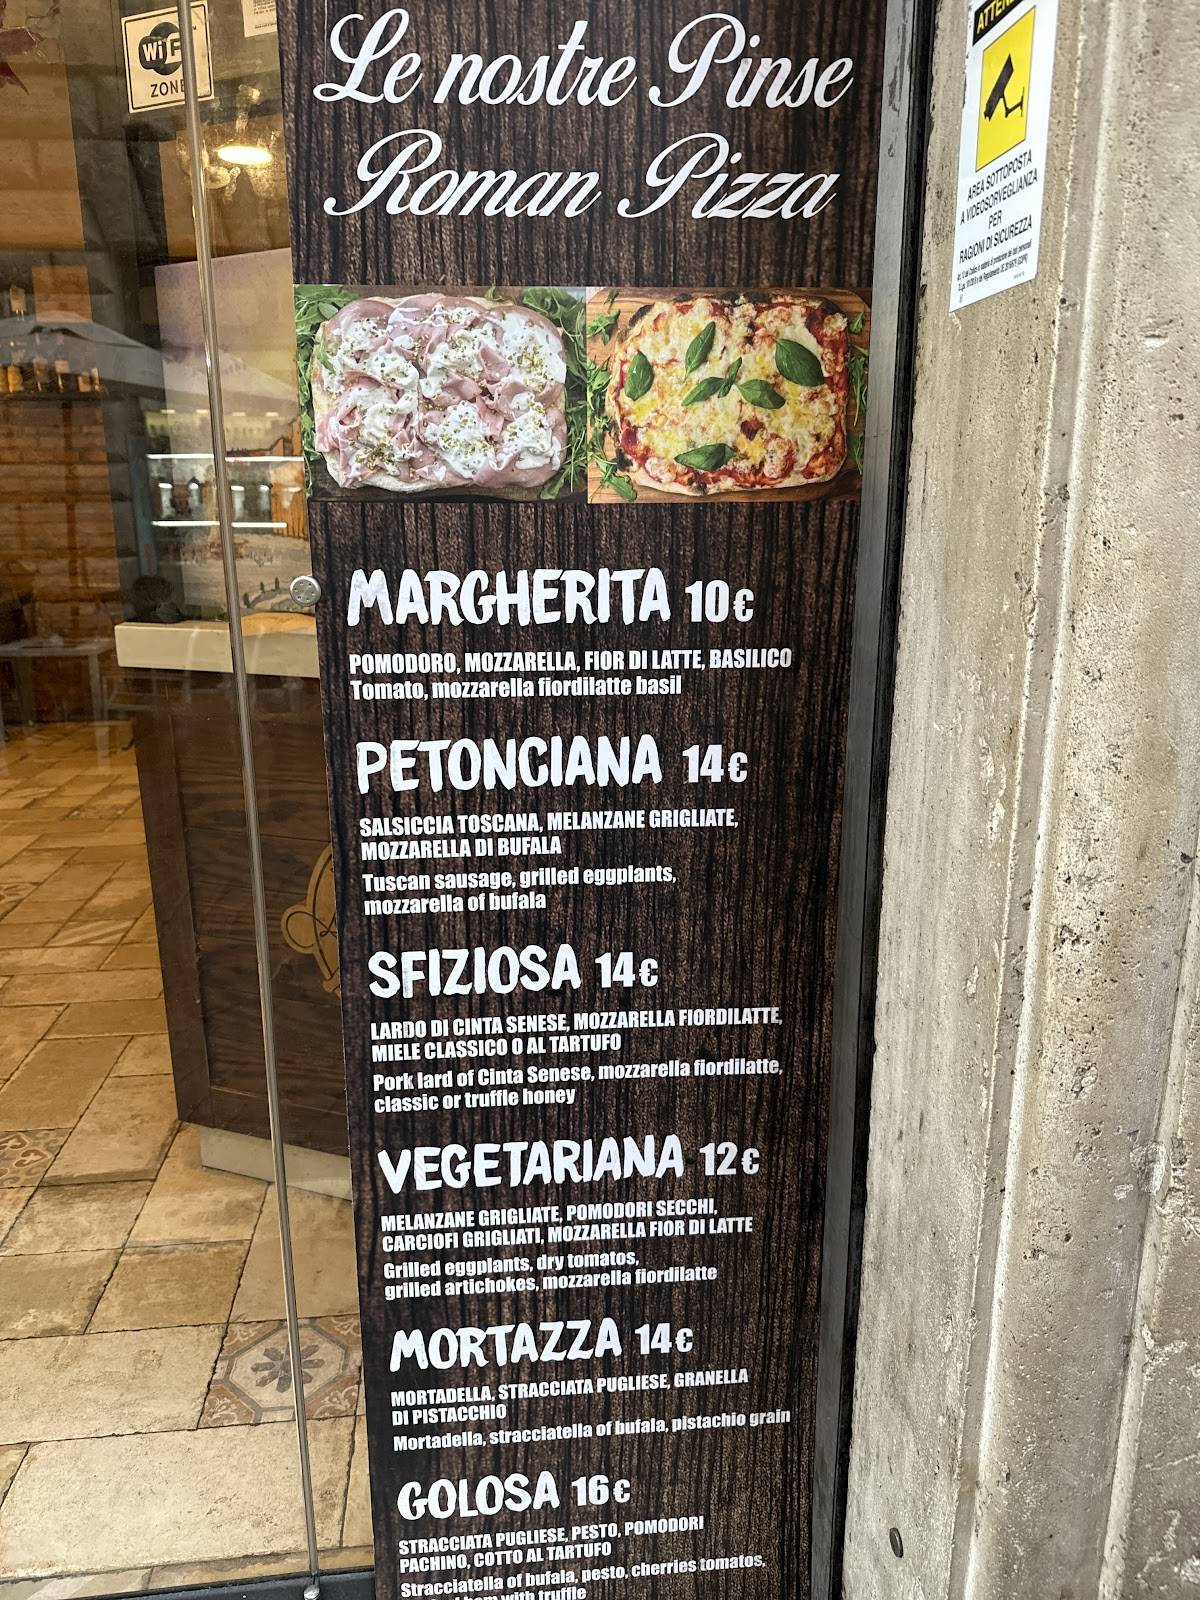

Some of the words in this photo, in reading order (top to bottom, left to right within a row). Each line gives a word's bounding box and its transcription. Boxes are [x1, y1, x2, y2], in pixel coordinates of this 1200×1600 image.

[976, 0, 1016, 35] ATTEN
[312, 8, 424, 104] Le
[432, 19, 638, 107] nostre
[648, 12, 854, 109] Pinse
[323, 128, 602, 218] Roman
[616, 132, 841, 220] Pizza
[967, 179, 985, 202] AREA
[986, 149, 1032, 190] SOTTOPOSTA
[960, 210, 965, 226] A
[966, 167, 1038, 221] VIDEOSORVEGLIANZA
[988, 209, 1003, 230] PER
[959, 238, 985, 265] RAGIONI
[986, 235, 993, 251] DI
[993, 214, 1032, 247] SICUREZZA
[346, 567, 671, 627] MARGHERITA
[684, 579, 754, 623] 10€
[349, 652, 461, 675] POMODORO,
[464, 651, 581, 673] MOZZARELLA,
[584, 650, 625, 671] FIOR
[628, 649, 648, 670] DI
[651, 649, 706, 671] LATTE,
[709, 647, 792, 669] BASILICO
[349, 680, 429, 701] Tomato,
[431, 677, 535, 699] mozzarella
[537, 676, 632, 697] fiordilatte
[635, 674, 682, 696] basil
[355, 733, 663, 795] PETONCIANA
[682, 744, 748, 783] 14€
[359, 815, 455, 837] SALSICCIA
[456, 812, 544, 834] TOSCANA,
[547, 809, 646, 831] MELANZANE
[648, 808, 739, 829] GRIGLIATE,
[360, 838, 472, 861] MOZZARELLA
[474, 837, 494, 857] DI
[497, 835, 562, 856] BUFALA
[361, 873, 431, 892] Tuscan
[434, 871, 517, 890] sausage,
[519, 866, 580, 889] grilled
[583, 864, 677, 886] eggplants,
[364, 894, 464, 916] mozzarella
[467, 892, 486, 912] of
[488, 891, 547, 911] bufala
[367, 943, 582, 999] SFIZIOSA
[594, 951, 659, 988] 14€
[370, 1019, 427, 1041] LARDO
[430, 1018, 449, 1038] DI
[452, 1016, 504, 1037] CINTA
[505, 1013, 571, 1034] SENESE,
[573, 1009, 676, 1031] MOZZARELLA
[678, 1006, 783, 1027] FIORDILATTE,
[371, 1042, 421, 1063] MIELE
[424, 1038, 508, 1060] CLASSICO
[511, 1037, 524, 1056] O
[526, 1036, 547, 1055] AL
[548, 1032, 622, 1054] TARTUFO
[373, 1072, 415, 1092] Pork
[417, 1070, 453, 1089] lard
[456, 1069, 475, 1087] of
[477, 1067, 524, 1086] Cinta
[526, 1065, 595, 1084] Senese,
[598, 1059, 691, 1080] mozzarella
[693, 1057, 783, 1076] fiordilatte,
[374, 1093, 439, 1114] classic
[442, 1094, 462, 1110] or
[463, 1089, 519, 1108] truffle
[522, 1088, 576, 1105] honey
[377, 1133, 685, 1194] VEGETARIANA
[699, 1141, 760, 1176] 12€
[380, 1210, 475, 1232] MELANZANE
[478, 1205, 563, 1227] GRIGLIATE,
[566, 1200, 653, 1222] POMODORI
[655, 1198, 718, 1217] SECCHI,
[382, 1232, 459, 1253] CARCIOFI
[462, 1227, 545, 1248] GRIGLIATI,
[547, 1221, 647, 1243] MOZZARELLA
[649, 1219, 685, 1237] FIOR
[688, 1218, 706, 1235] DI
[709, 1216, 753, 1234] LATTE
[383, 1260, 442, 1280] Grilled
[444, 1256, 534, 1277] eggplants,
[536, 1254, 565, 1271] dry
[566, 1251, 640, 1269] tomatos,
[384, 1280, 442, 1301] grilled
[444, 1276, 540, 1296] artichokes,
[542, 1269, 632, 1290] mozzarella
[634, 1266, 718, 1285] fiordilatte
[389, 1317, 623, 1373] MORTAZZA
[634, 1322, 694, 1355] 14€
[390, 1385, 496, 1407] MORTADELLA,
[497, 1378, 594, 1401] STRACCIATA
[596, 1373, 671, 1393] PUGLIESE,
[673, 1368, 749, 1388] GRANELLA
[391, 1409, 409, 1426] DI
[412, 1403, 507, 1425] PISTACCHIO
[393, 1430, 487, 1452] Mortadella,
[488, 1422, 593, 1445] stracciatella
[595, 1420, 613, 1437] of
[614, 1417, 669, 1436] bufala,
[671, 1411, 746, 1433] pistachio
[749, 1408, 791, 1427] grain
[396, 1470, 561, 1521] GOLOSA
[571, 1474, 631, 1507] 16€
[398, 1533, 493, 1556] STRACCIATA
[495, 1527, 569, 1548] PUGLIESE,
[571, 1522, 622, 1541] PESTO,
[624, 1515, 704, 1537] POMODORI
[399, 1553, 471, 1574] PACHINO,
[473, 1549, 524, 1568] COTTO
[525, 1547, 544, 1563] AL
[546, 1541, 612, 1561] TARTUFO
[400, 1575, 504, 1598] Stracciatella
[506, 1573, 523, 1589] of
[525, 1569, 579, 1588] bufala,
[581, 1565, 629, 1584] pesto,
[631, 1559, 697, 1578] cherries
[699, 1554, 766, 1572] tomatos,
[538, 1586, 587, 1600] truffle
